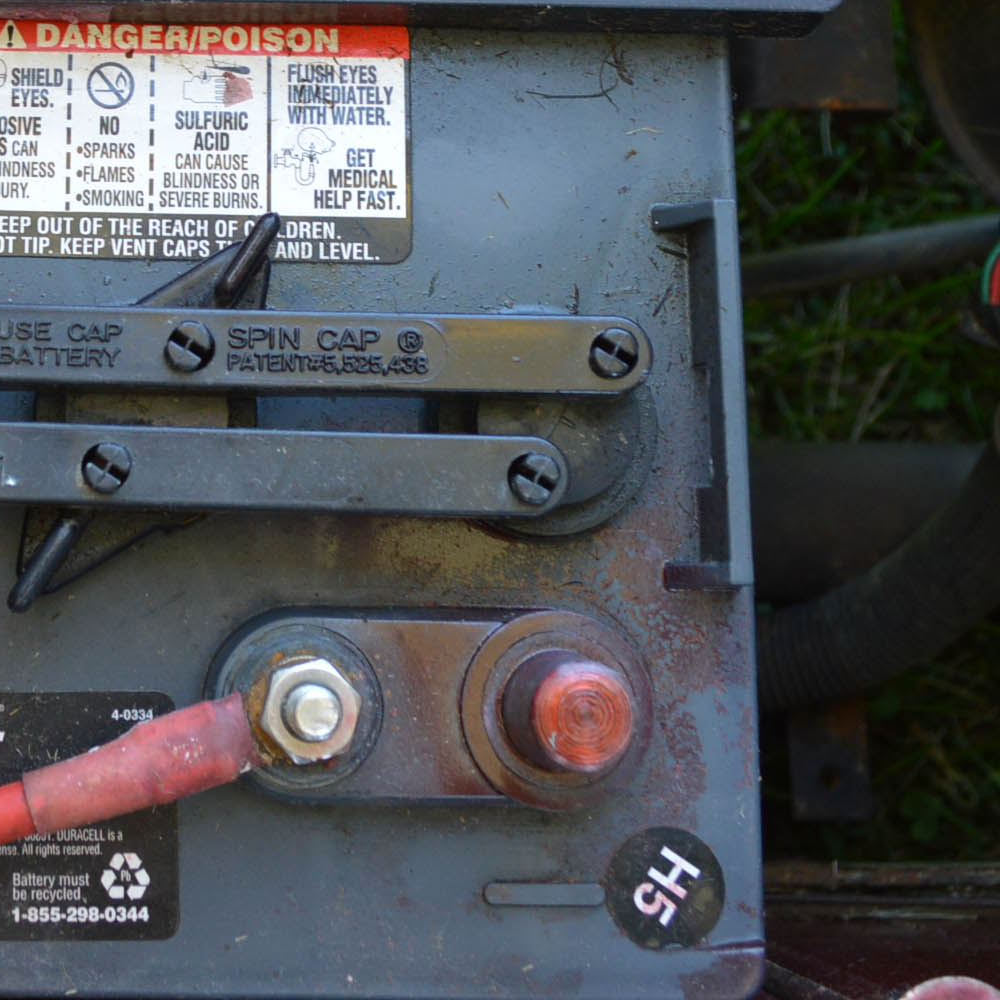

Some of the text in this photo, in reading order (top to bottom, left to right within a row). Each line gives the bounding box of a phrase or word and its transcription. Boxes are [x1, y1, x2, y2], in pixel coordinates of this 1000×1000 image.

[36, 23, 340, 53] DANGER/POISON
[11, 67, 64, 87] SHIELD
[288, 64, 377, 84] FLUSH EYES
[11, 89, 54, 108] EYES.
[288, 85, 394, 106] IMMEDIATELY
[175, 110, 248, 131] SULFURIC
[288, 105, 391, 126] WITH WATER.
[99, 116, 120, 135] NO
[12, 141, 38, 156] CAN
[194, 132, 230, 151] ACID
[175, 153, 249, 171] CAN CAUSE
[346, 149, 375, 168] GET
[163, 173, 260, 190] BLINDNESS OR
[328, 169, 397, 188] MEDICAL
[159, 192, 263, 210] SEVERE BURNS.
[314, 190, 401, 211] HELP FAST.
[37, 216, 74, 235] OUT
[79, 217, 102, 235] OF
[108, 218, 143, 236] THE
[148, 219, 209, 237] REACH
[214, 220, 238, 237] OF
[21, 237, 54, 254] TIP.
[60, 238, 106, 255] KEEP
[111, 238, 157, 257] VENT
[163, 239, 210, 257] CAPS
[275, 241, 314, 259] AND
[319, 242, 380, 261] LEVEL.
[67, 322, 123, 343] CAP
[227, 325, 381, 351] SPIN CAP
[111, 709, 153, 721] 4-0334
[22, 845, 34, 856] All
[35, 845, 60, 858] rights
[12, 872, 90, 889] Battery must
[12, 886, 27, 900] be
[12, 906, 150, 922] 1-855-298-0344
